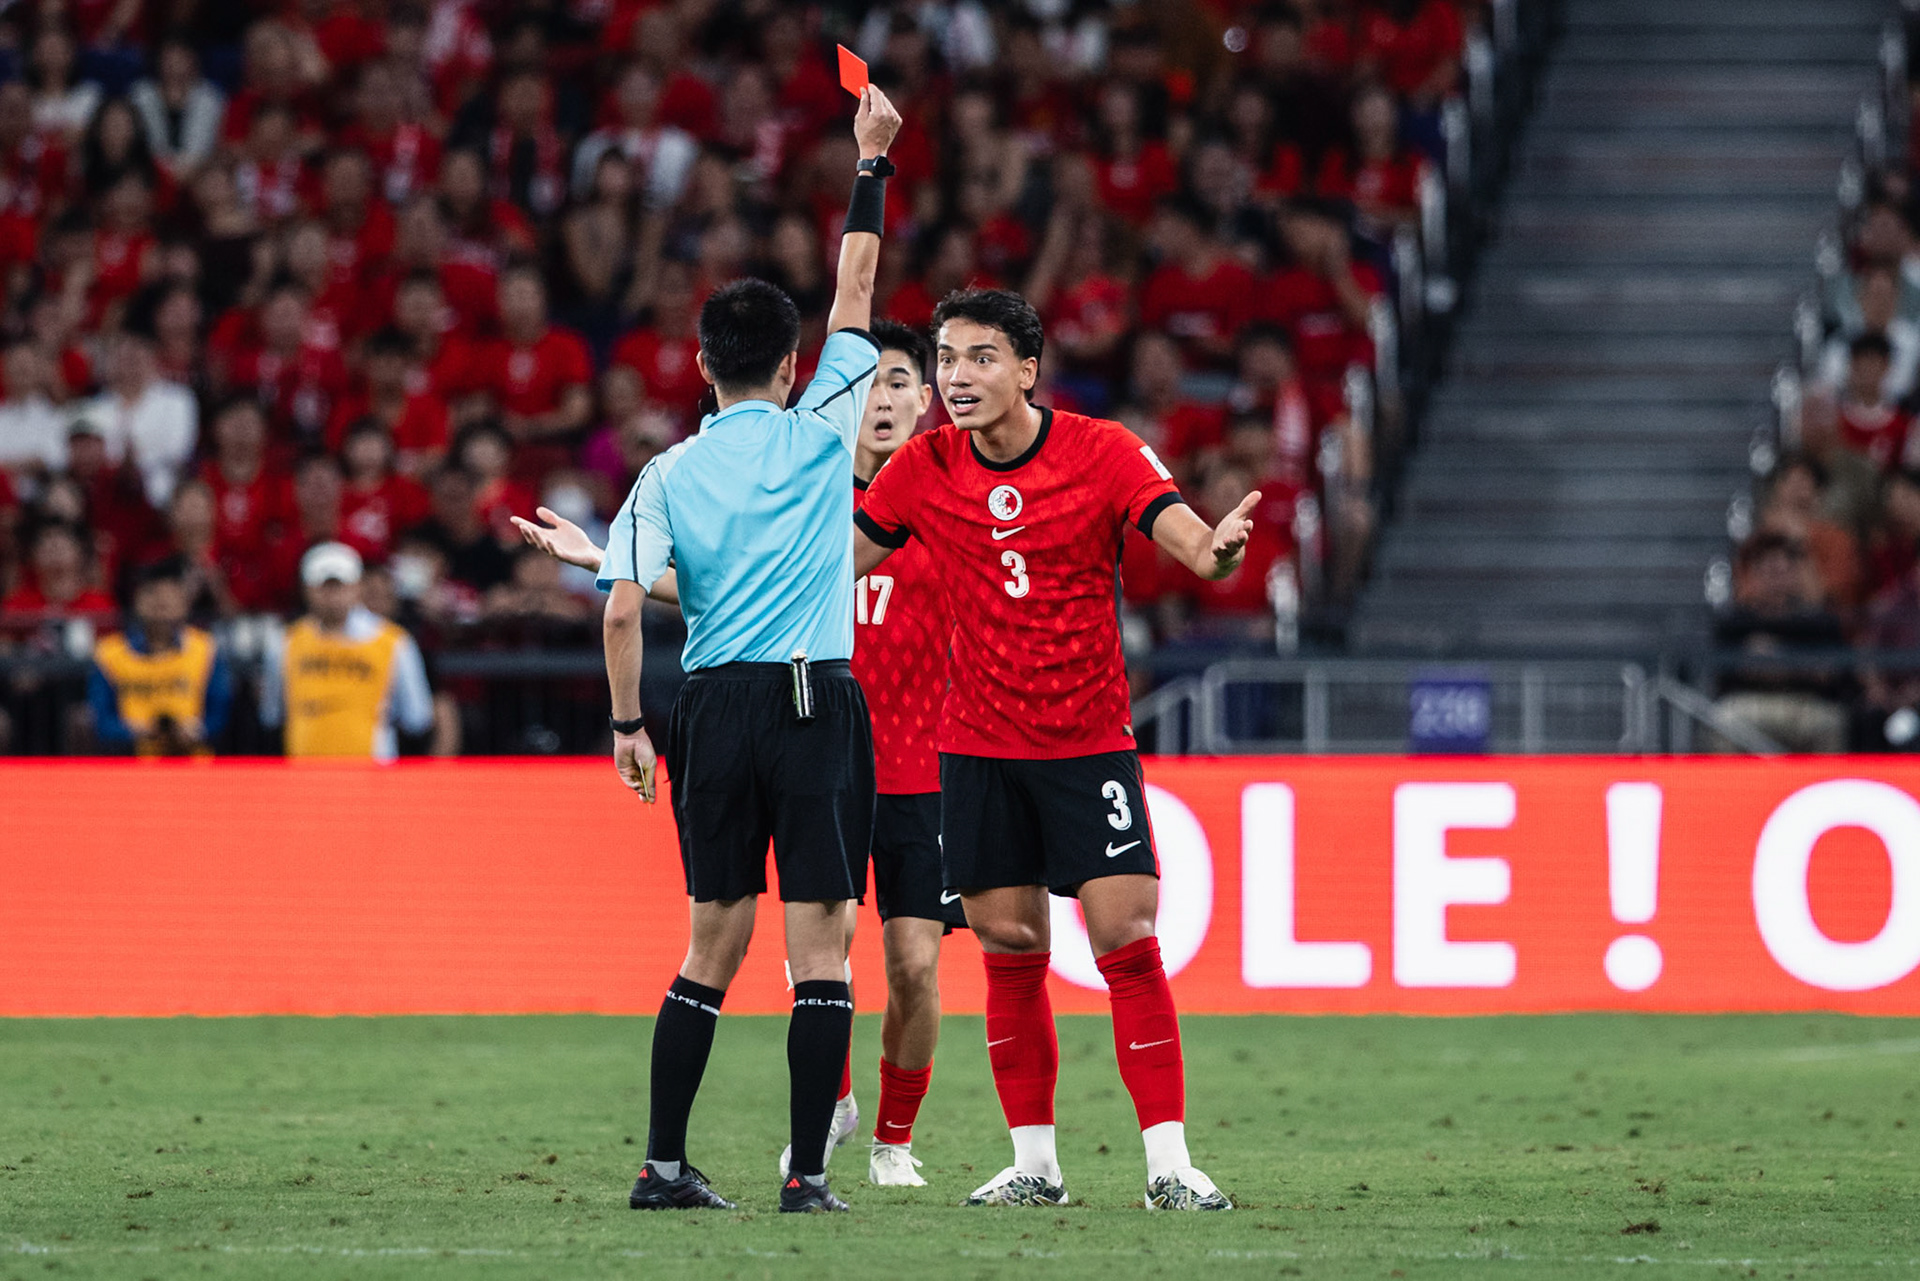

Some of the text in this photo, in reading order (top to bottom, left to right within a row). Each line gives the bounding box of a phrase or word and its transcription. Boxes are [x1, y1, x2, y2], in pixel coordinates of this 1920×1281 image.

[1001, 550, 1030, 598] 3
[854, 575, 894, 625] 17
[1102, 780, 1132, 830] 3
[797, 998, 846, 1008] KELME
